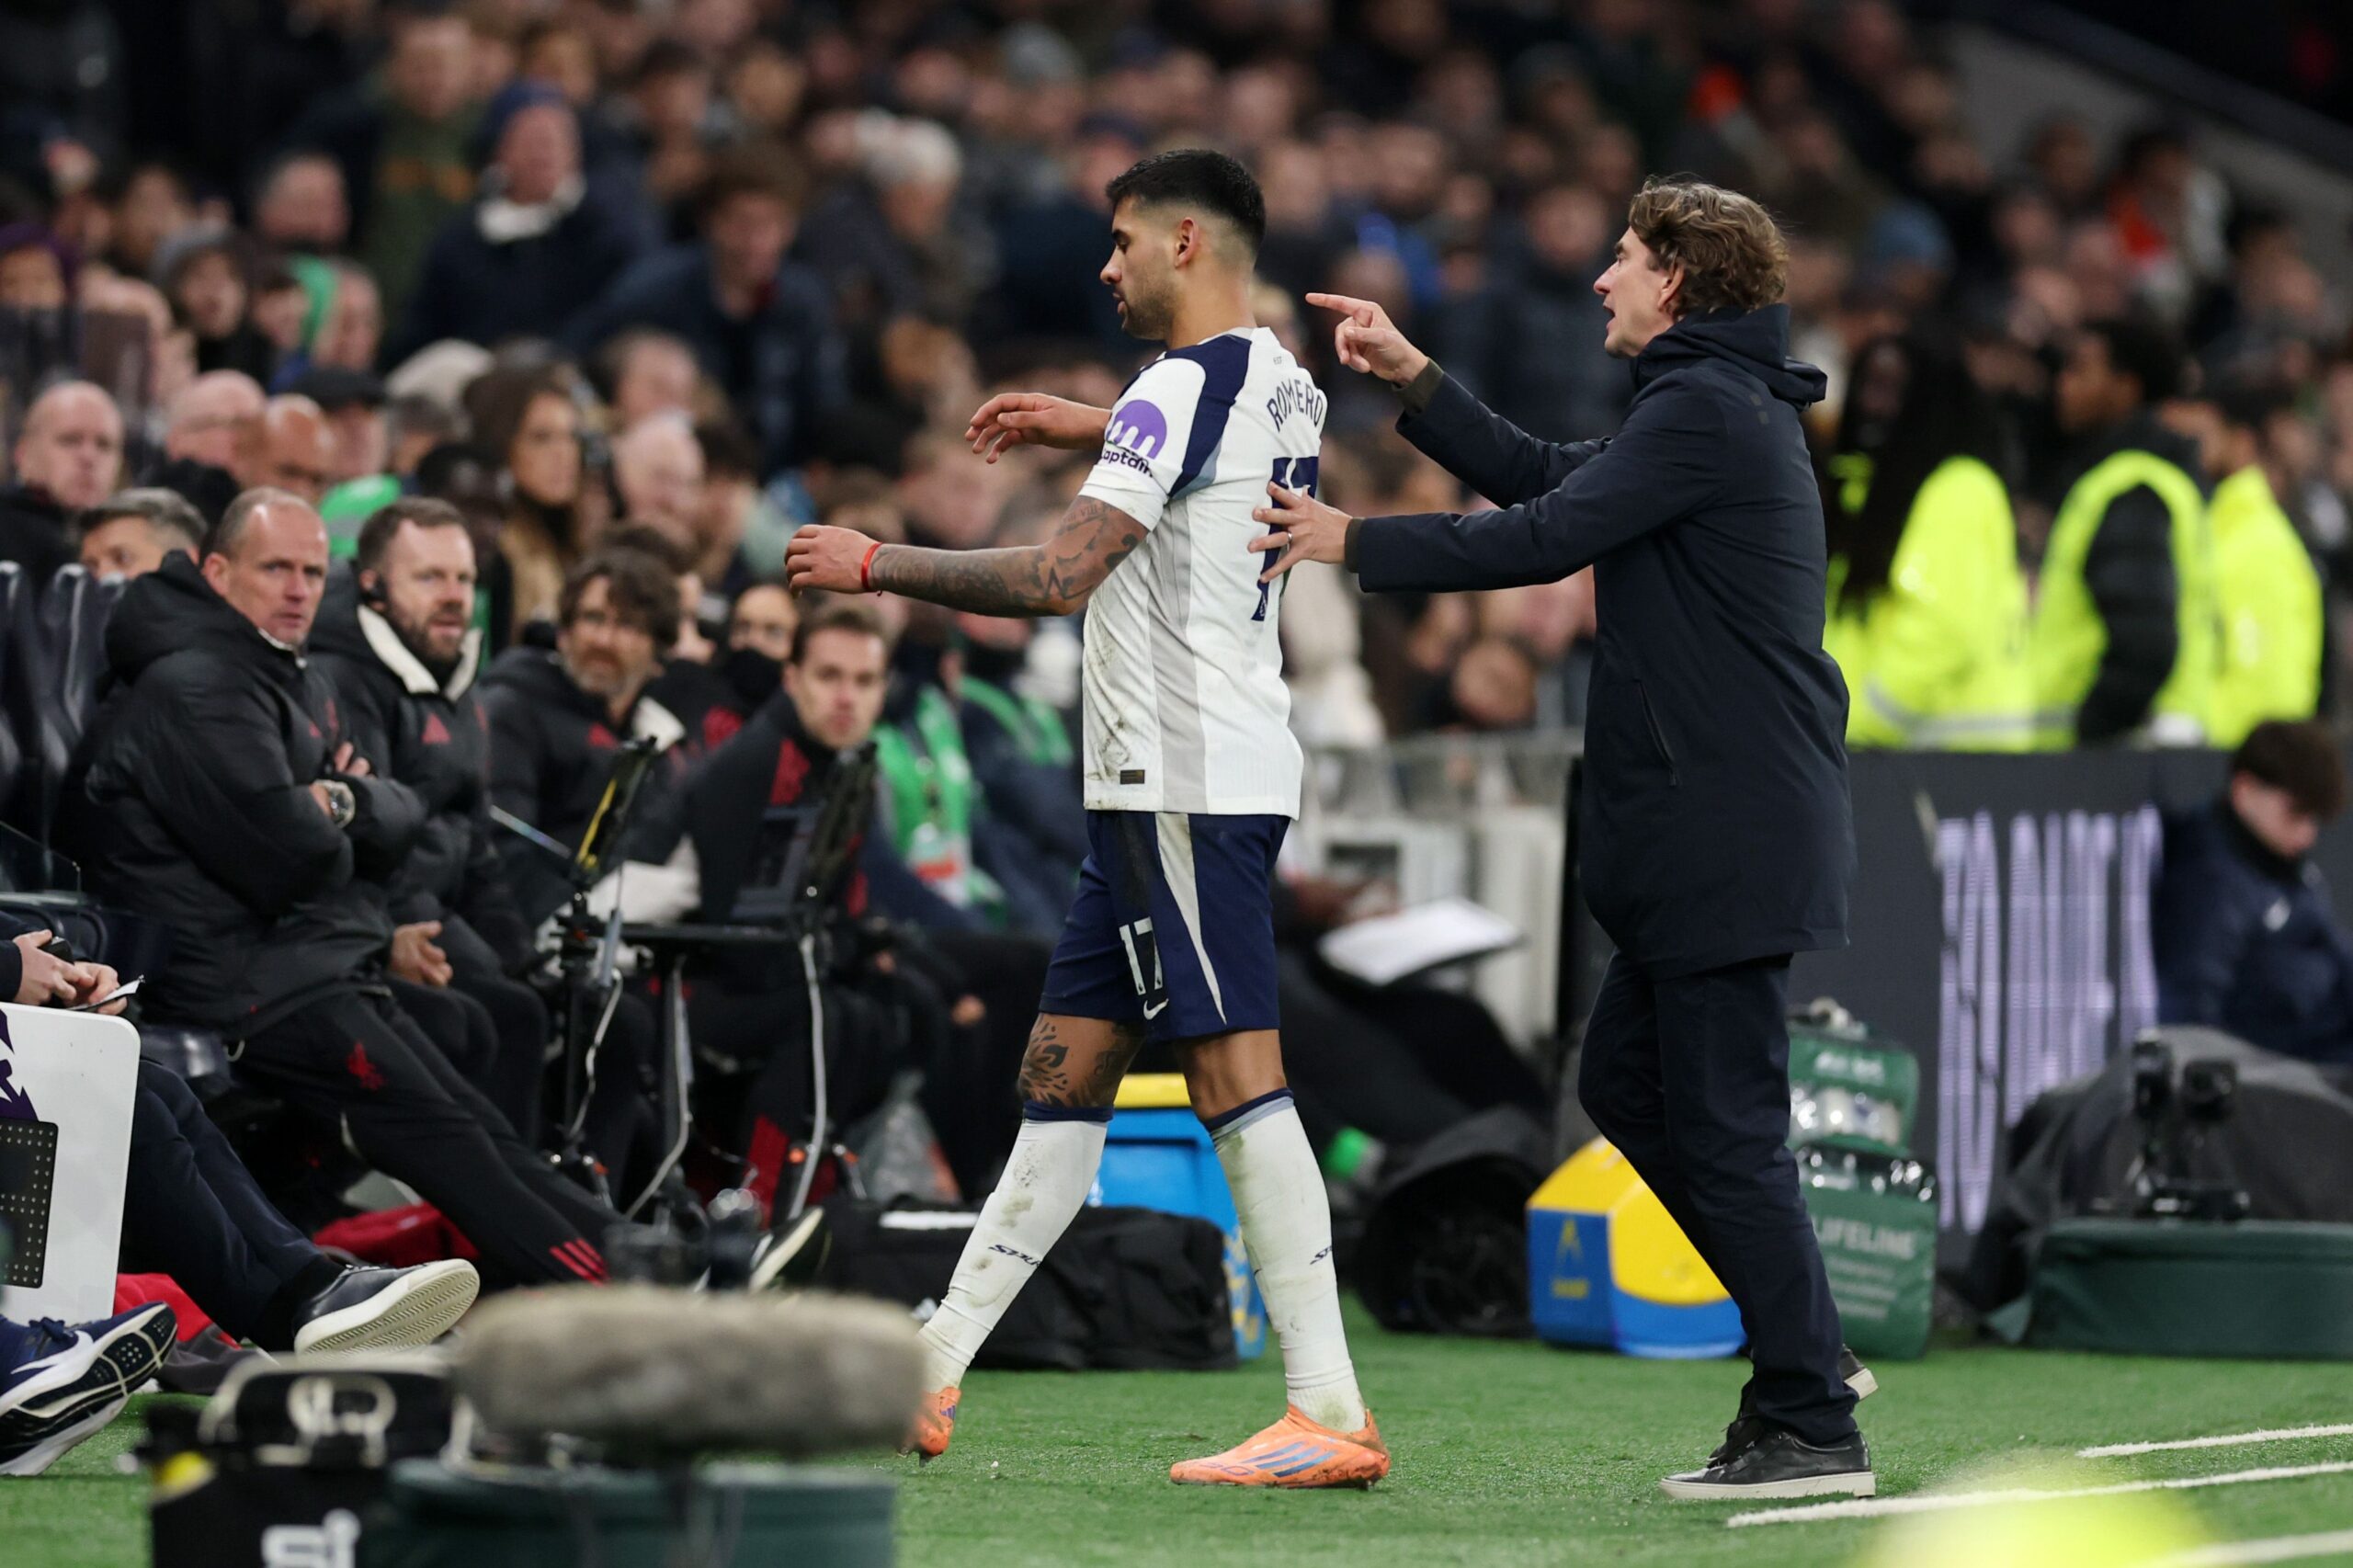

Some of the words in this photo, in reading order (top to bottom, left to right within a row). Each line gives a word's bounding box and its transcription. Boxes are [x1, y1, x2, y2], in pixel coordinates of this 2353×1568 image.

[1267, 378, 1324, 433] ROMERO
[1103, 449, 1154, 478] aptain
[1119, 916, 1164, 996] 17
